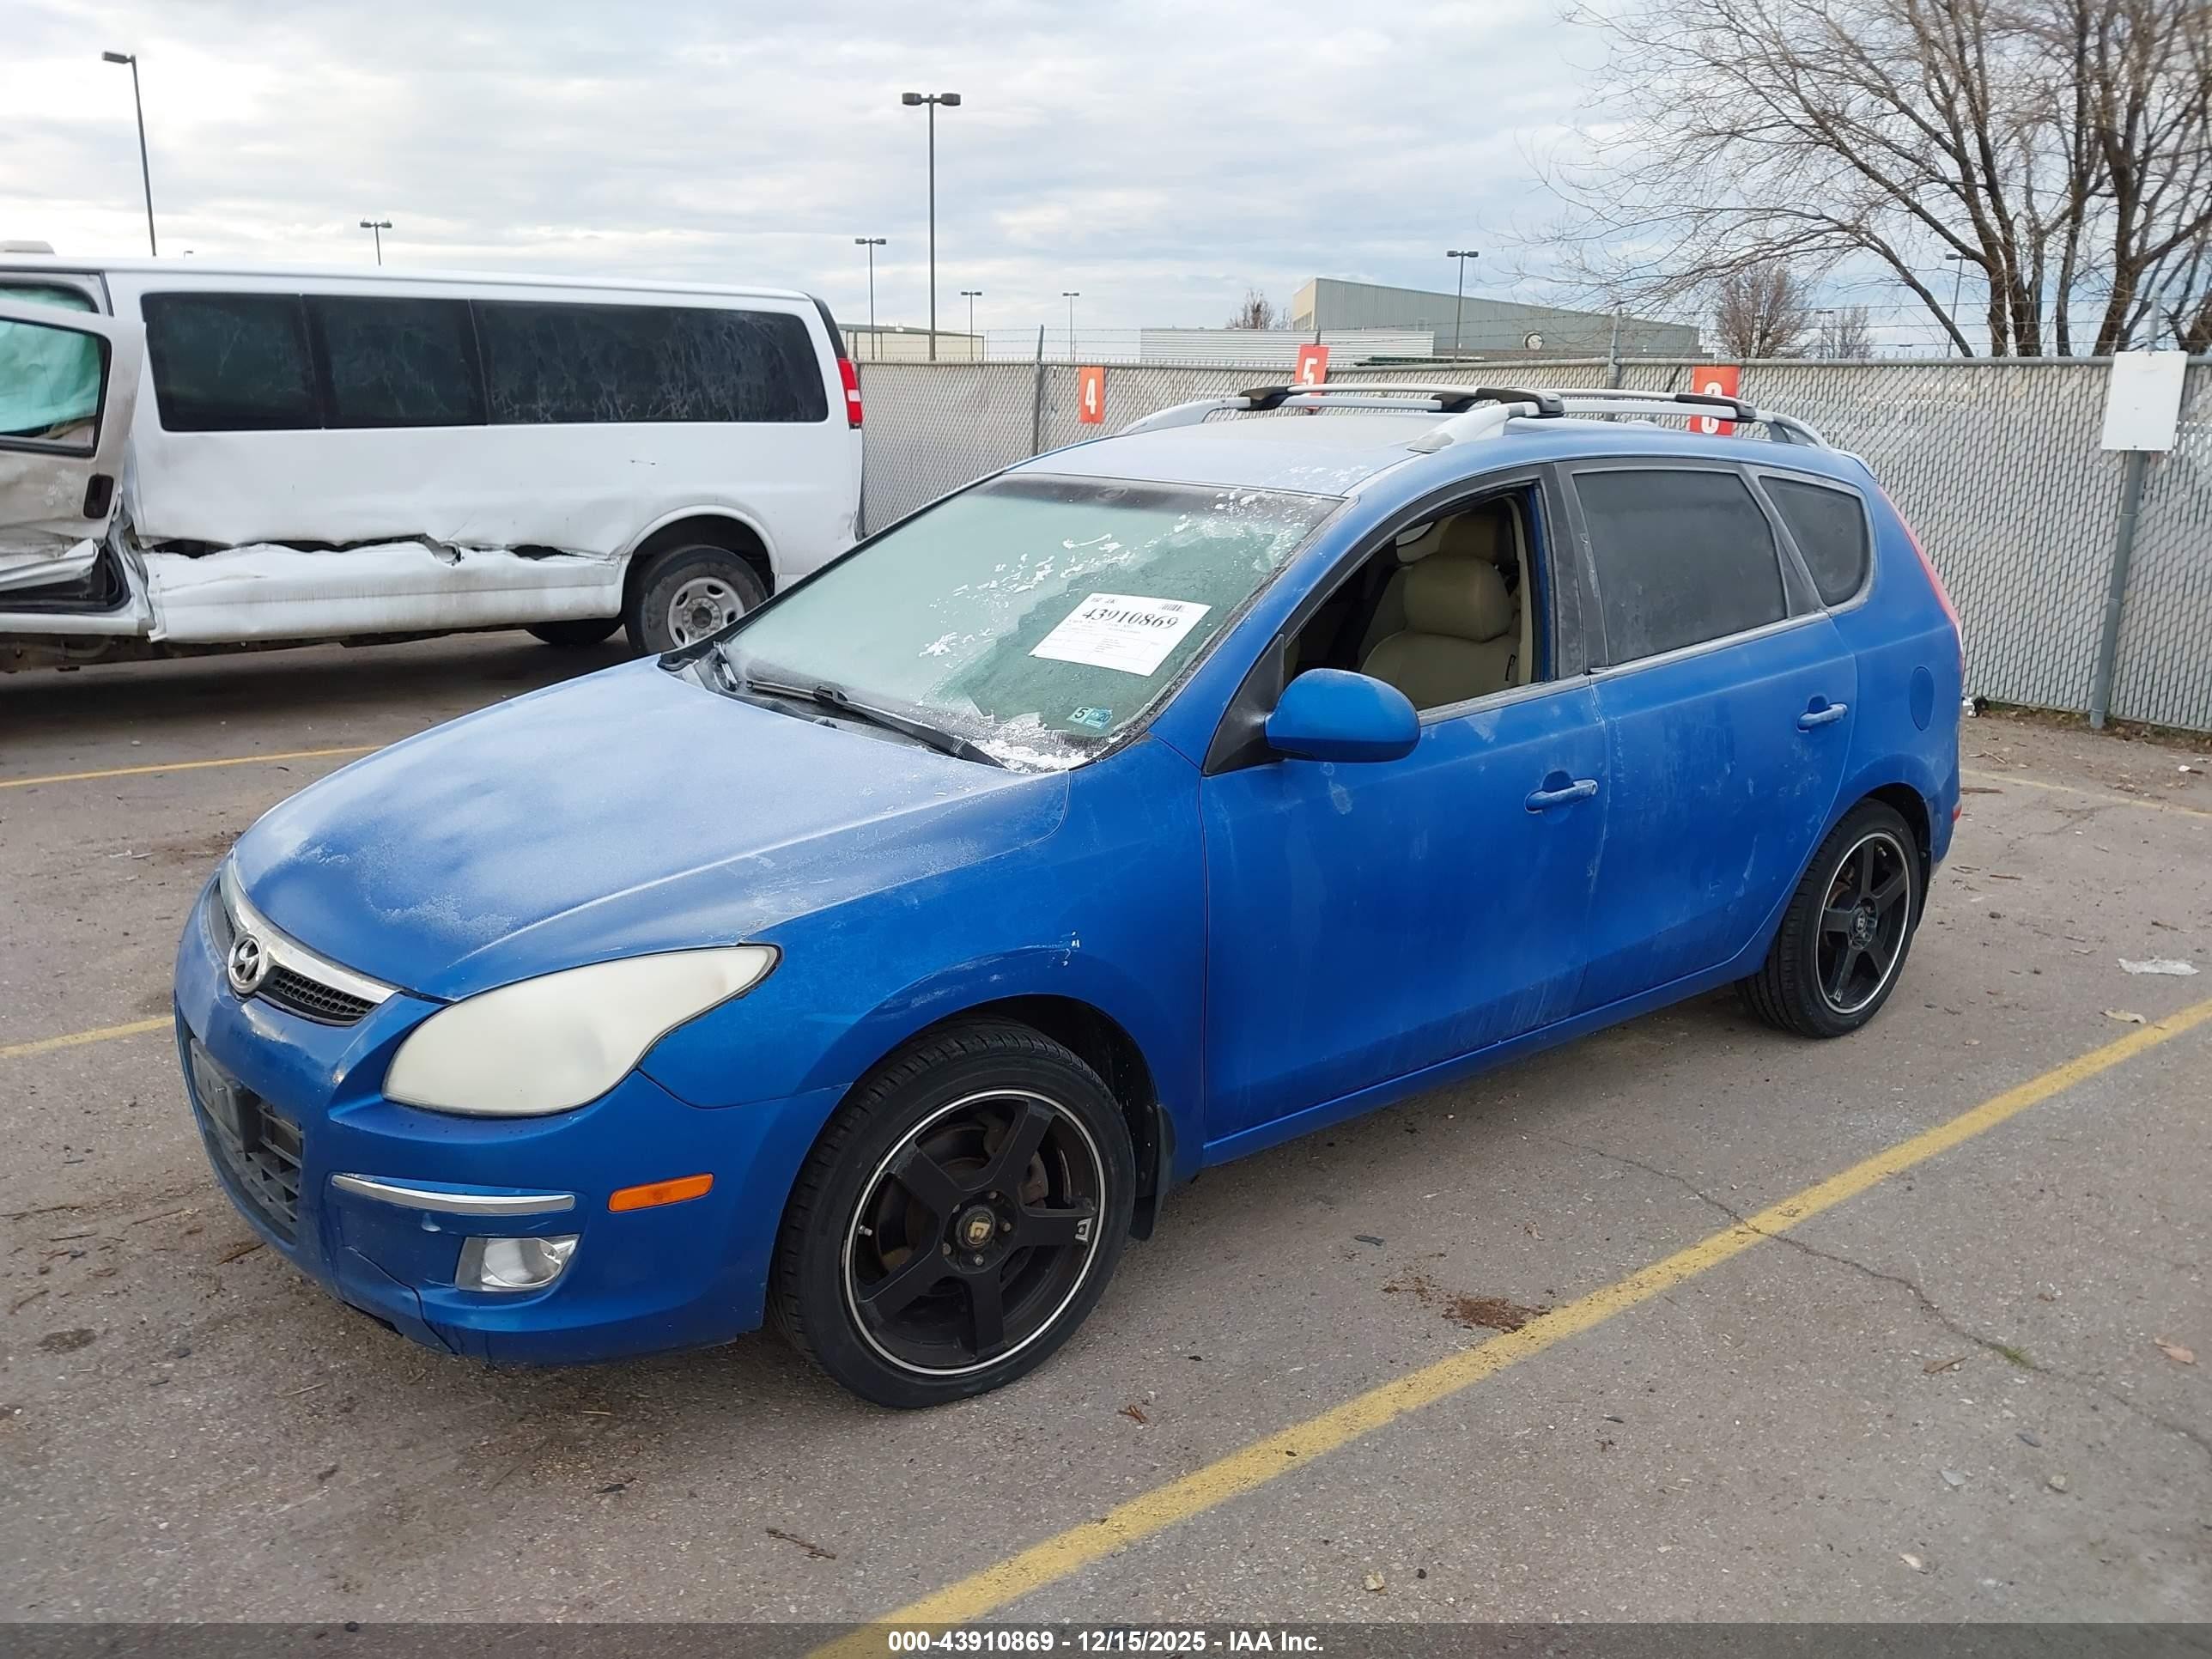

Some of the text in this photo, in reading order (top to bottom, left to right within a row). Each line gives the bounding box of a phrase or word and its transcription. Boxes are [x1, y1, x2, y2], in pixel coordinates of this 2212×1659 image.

[1085, 378, 1097, 415] 4
[1082, 608, 1179, 629] 43910869
[1074, 708, 1089, 719] 5
